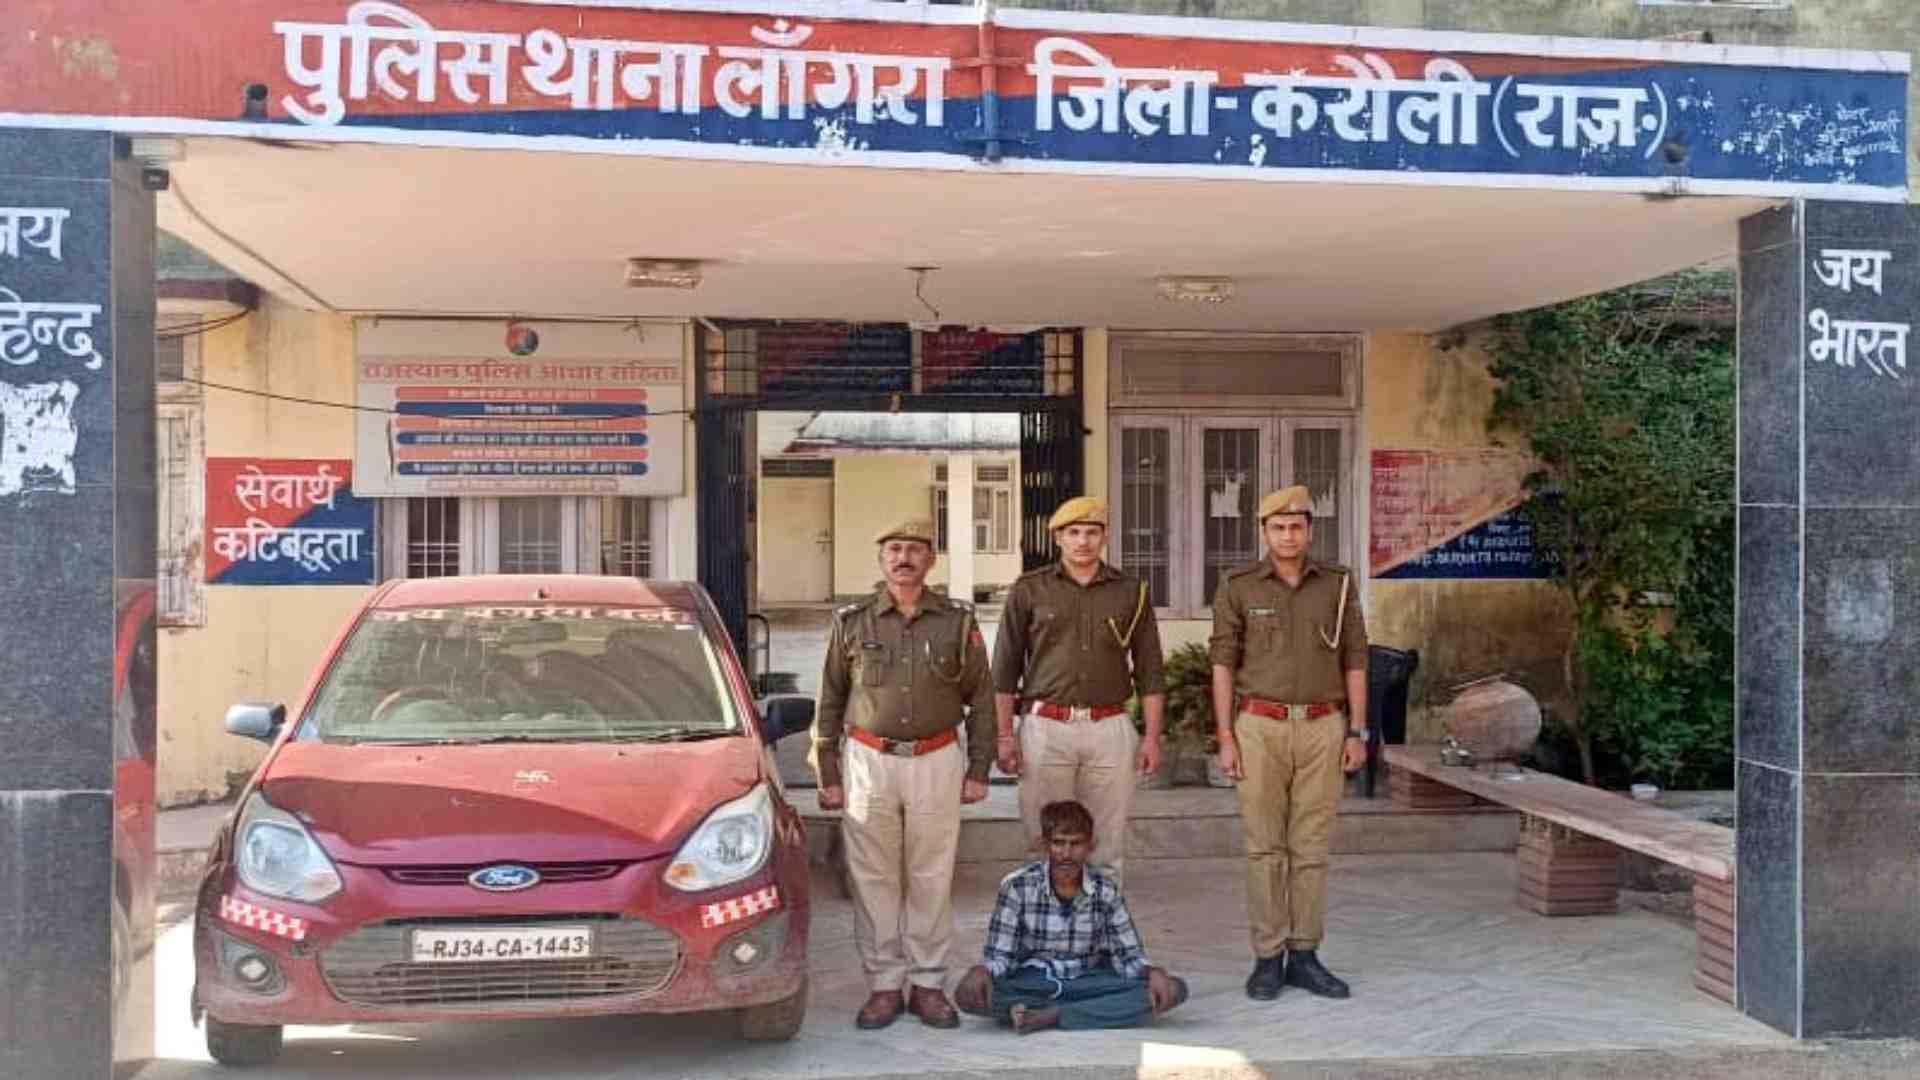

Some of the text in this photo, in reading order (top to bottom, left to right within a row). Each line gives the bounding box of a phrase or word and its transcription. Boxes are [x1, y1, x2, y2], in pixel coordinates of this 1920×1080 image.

[273, 1, 523, 126] पुलिस
[522, 28, 710, 114] थाना
[1813, 249, 1892, 296] जय
[1808, 308, 1911, 379] भारत
[432, 935, 585, 959] RJ34-CA-1443
